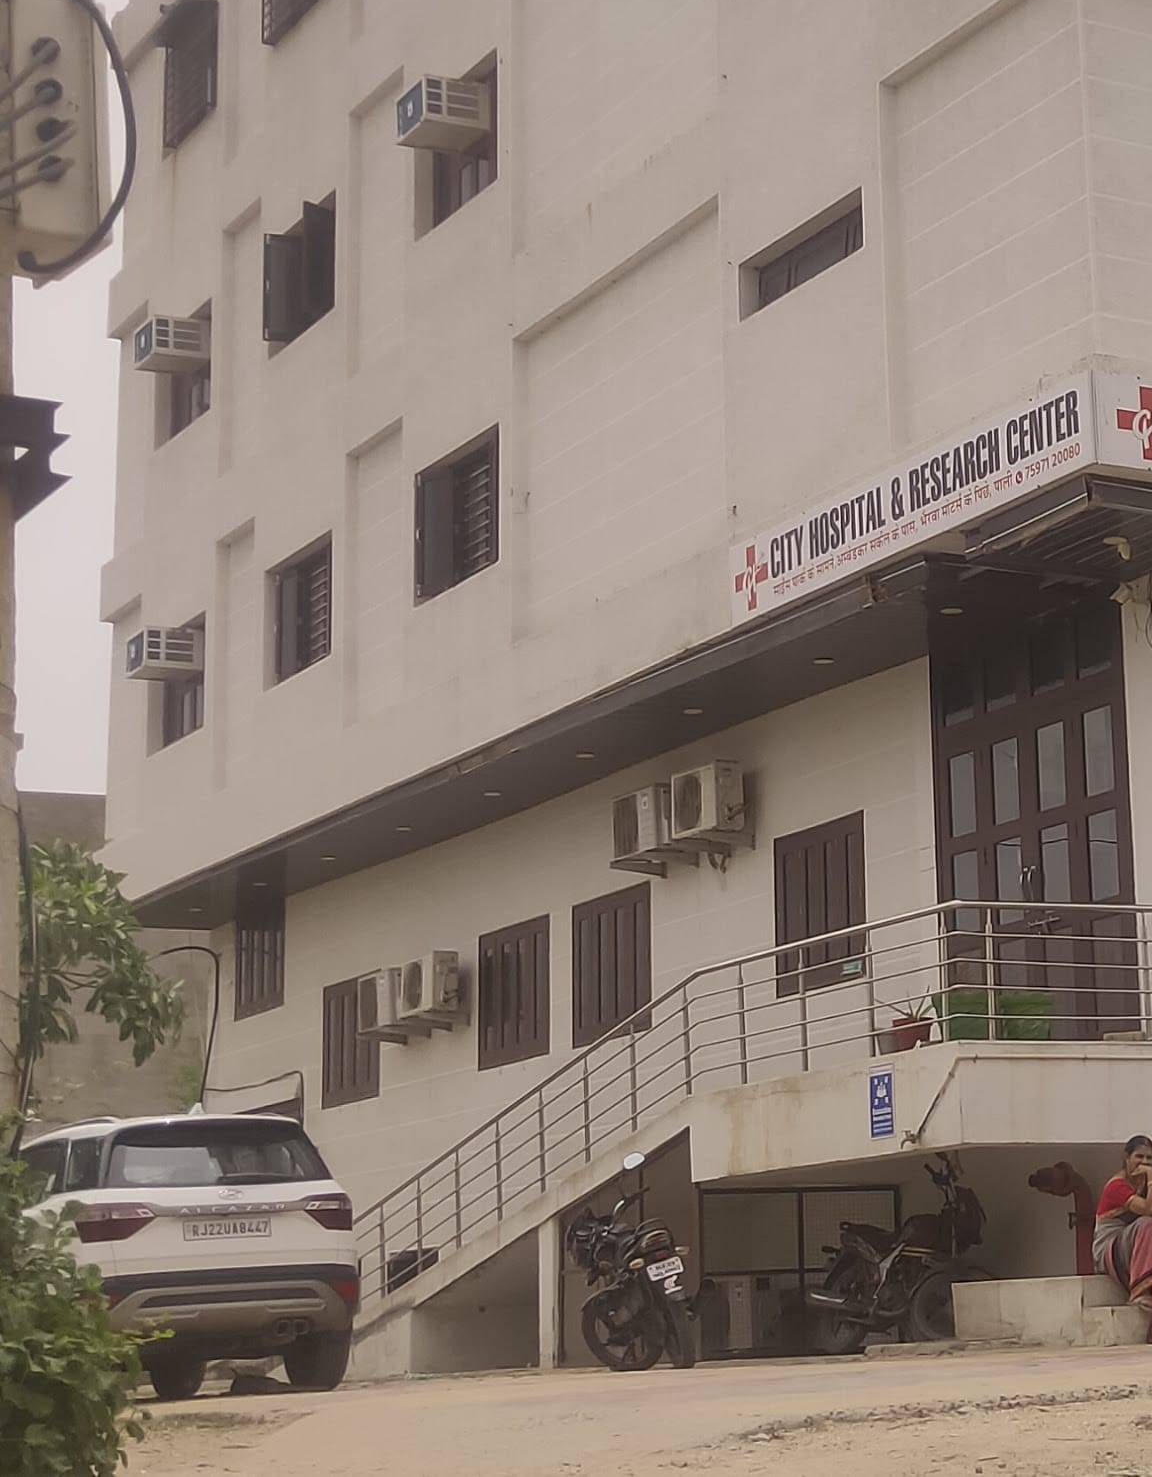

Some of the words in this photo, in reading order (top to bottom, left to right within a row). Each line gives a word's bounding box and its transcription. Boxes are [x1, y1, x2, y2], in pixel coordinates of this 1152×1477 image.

[770, 525, 803, 578] CITY
[809, 486, 886, 559] HOSPITAL
[890, 475, 905, 517] &
[909, 427, 1000, 511] RESEARCH
[1006, 389, 1080, 465] CENTER
[1024, 457, 1049, 479] 75971
[1052, 443, 1081, 466] 20080
